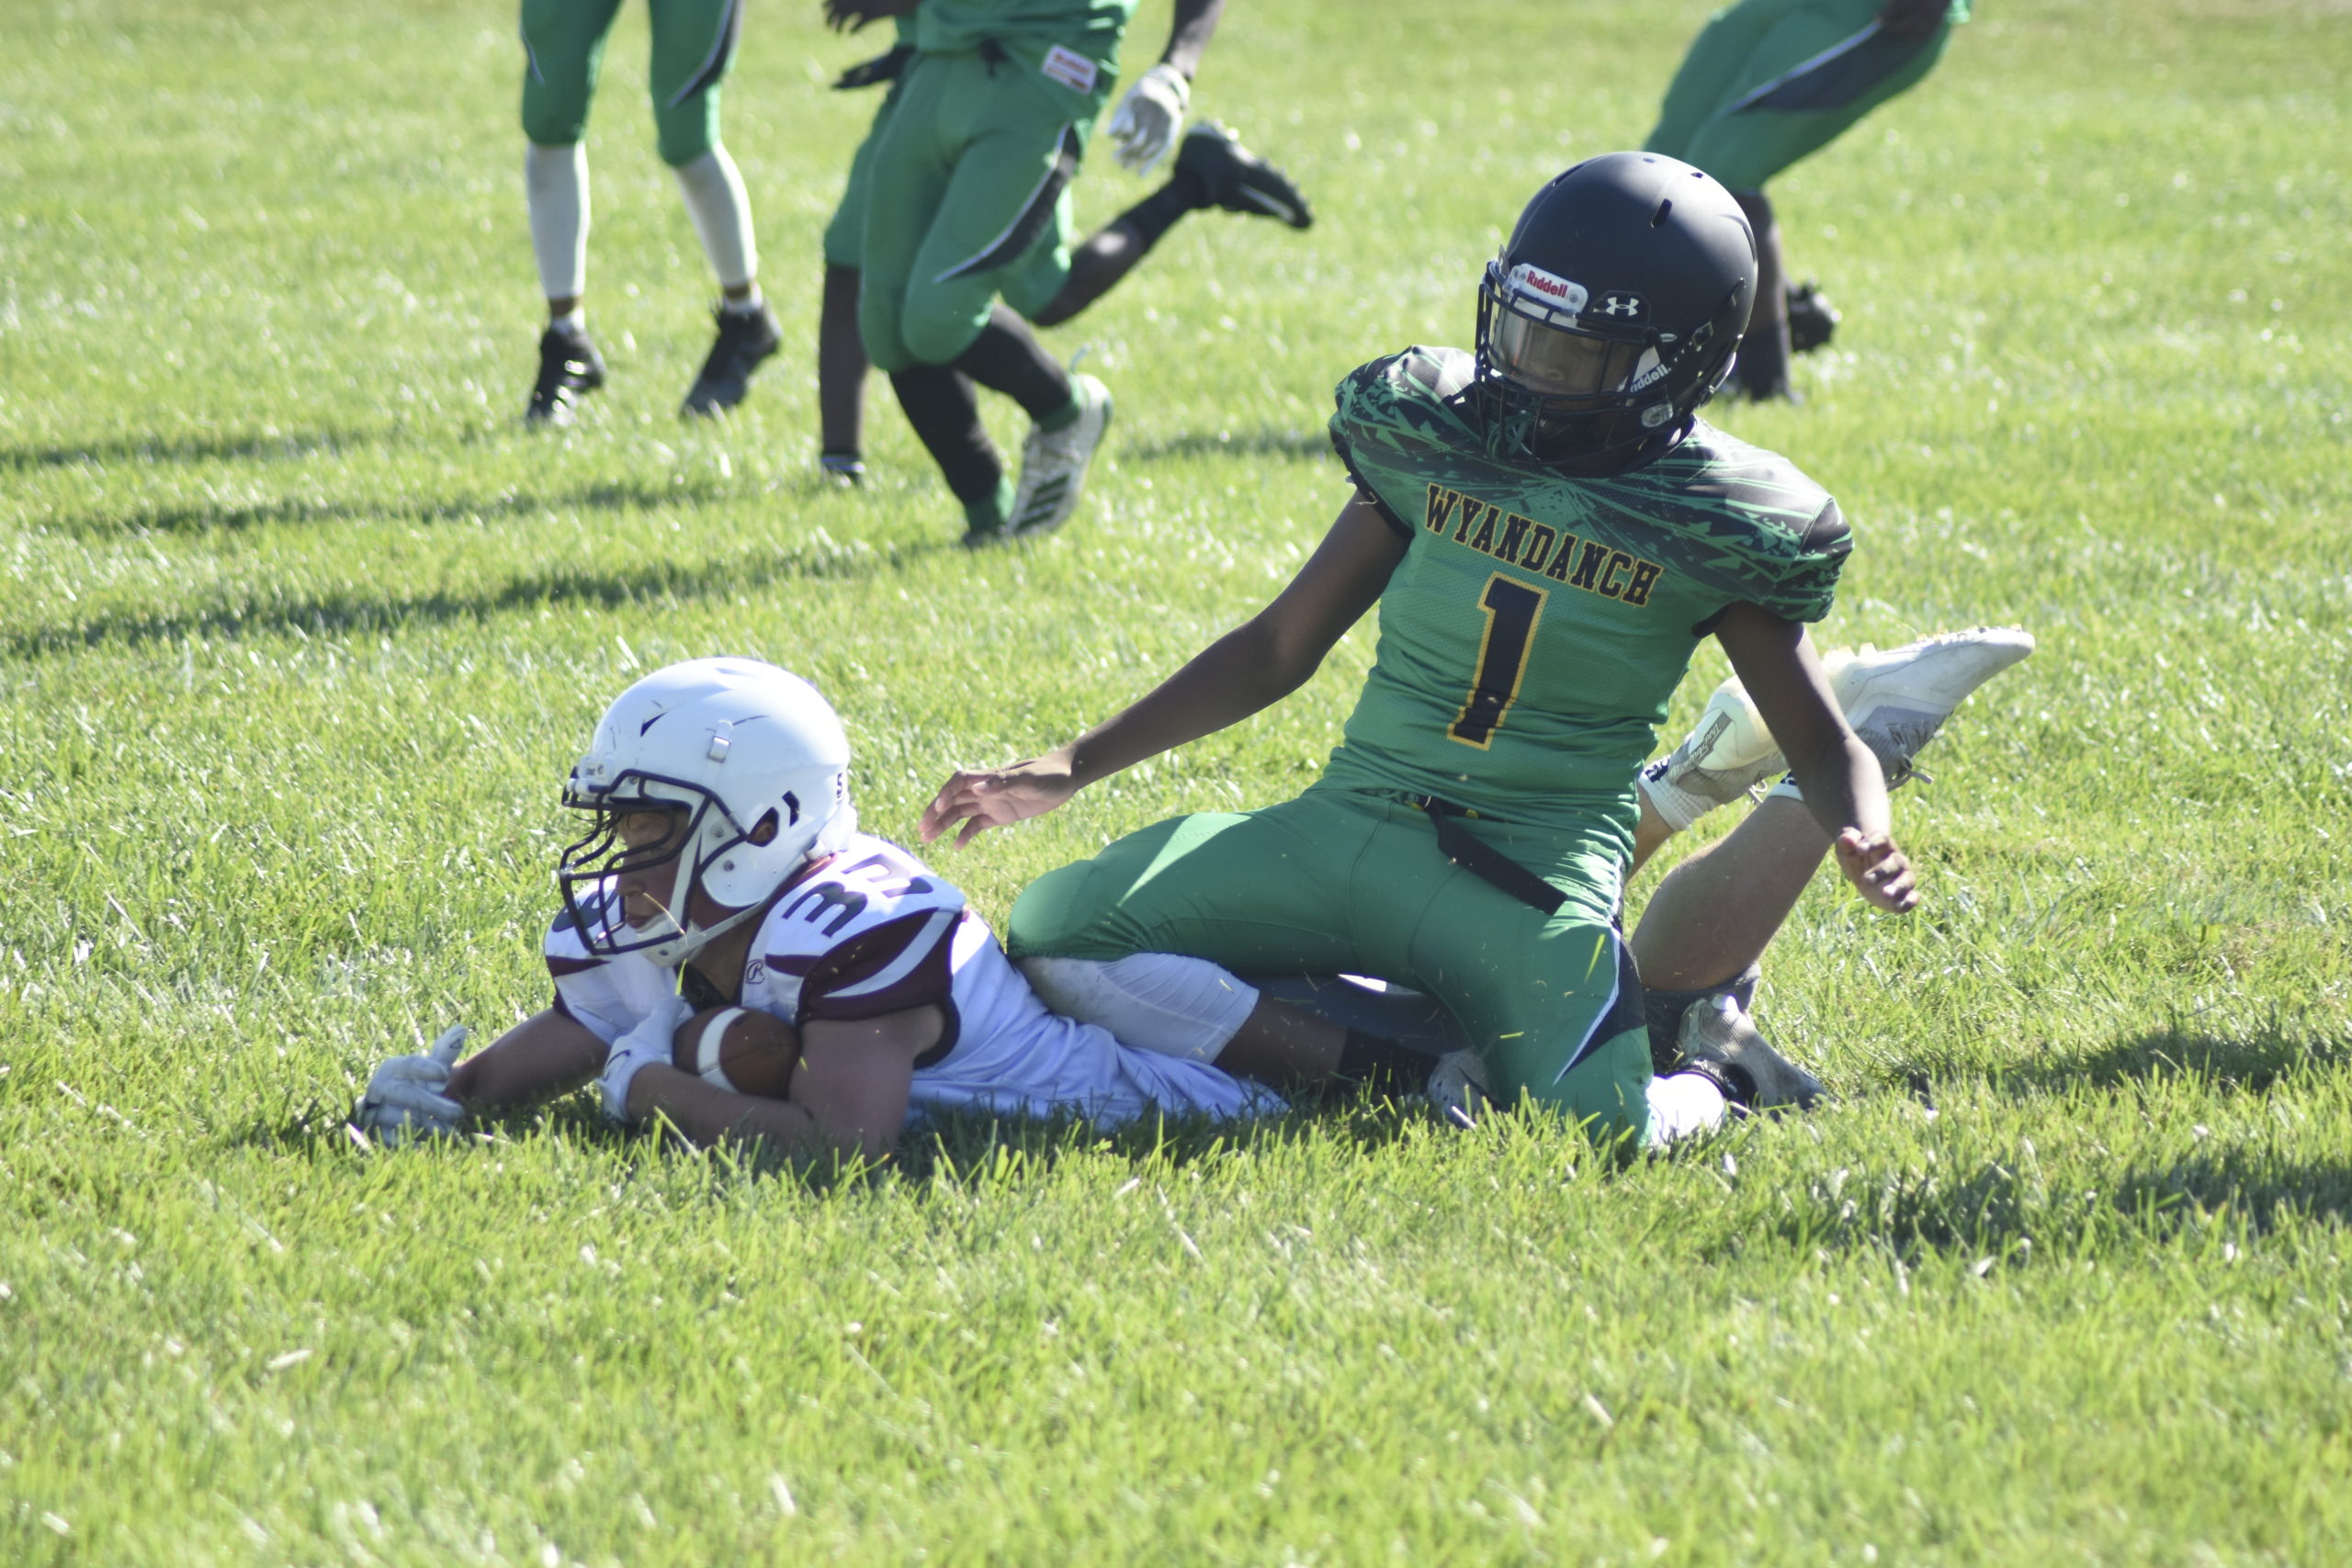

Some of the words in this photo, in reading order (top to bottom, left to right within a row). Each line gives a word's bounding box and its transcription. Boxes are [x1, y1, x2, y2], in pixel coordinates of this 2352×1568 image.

[1526, 270, 1568, 299] Riddell
[1425, 482, 1665, 608] WYANDANCH
[1447, 571, 1550, 751] 1
